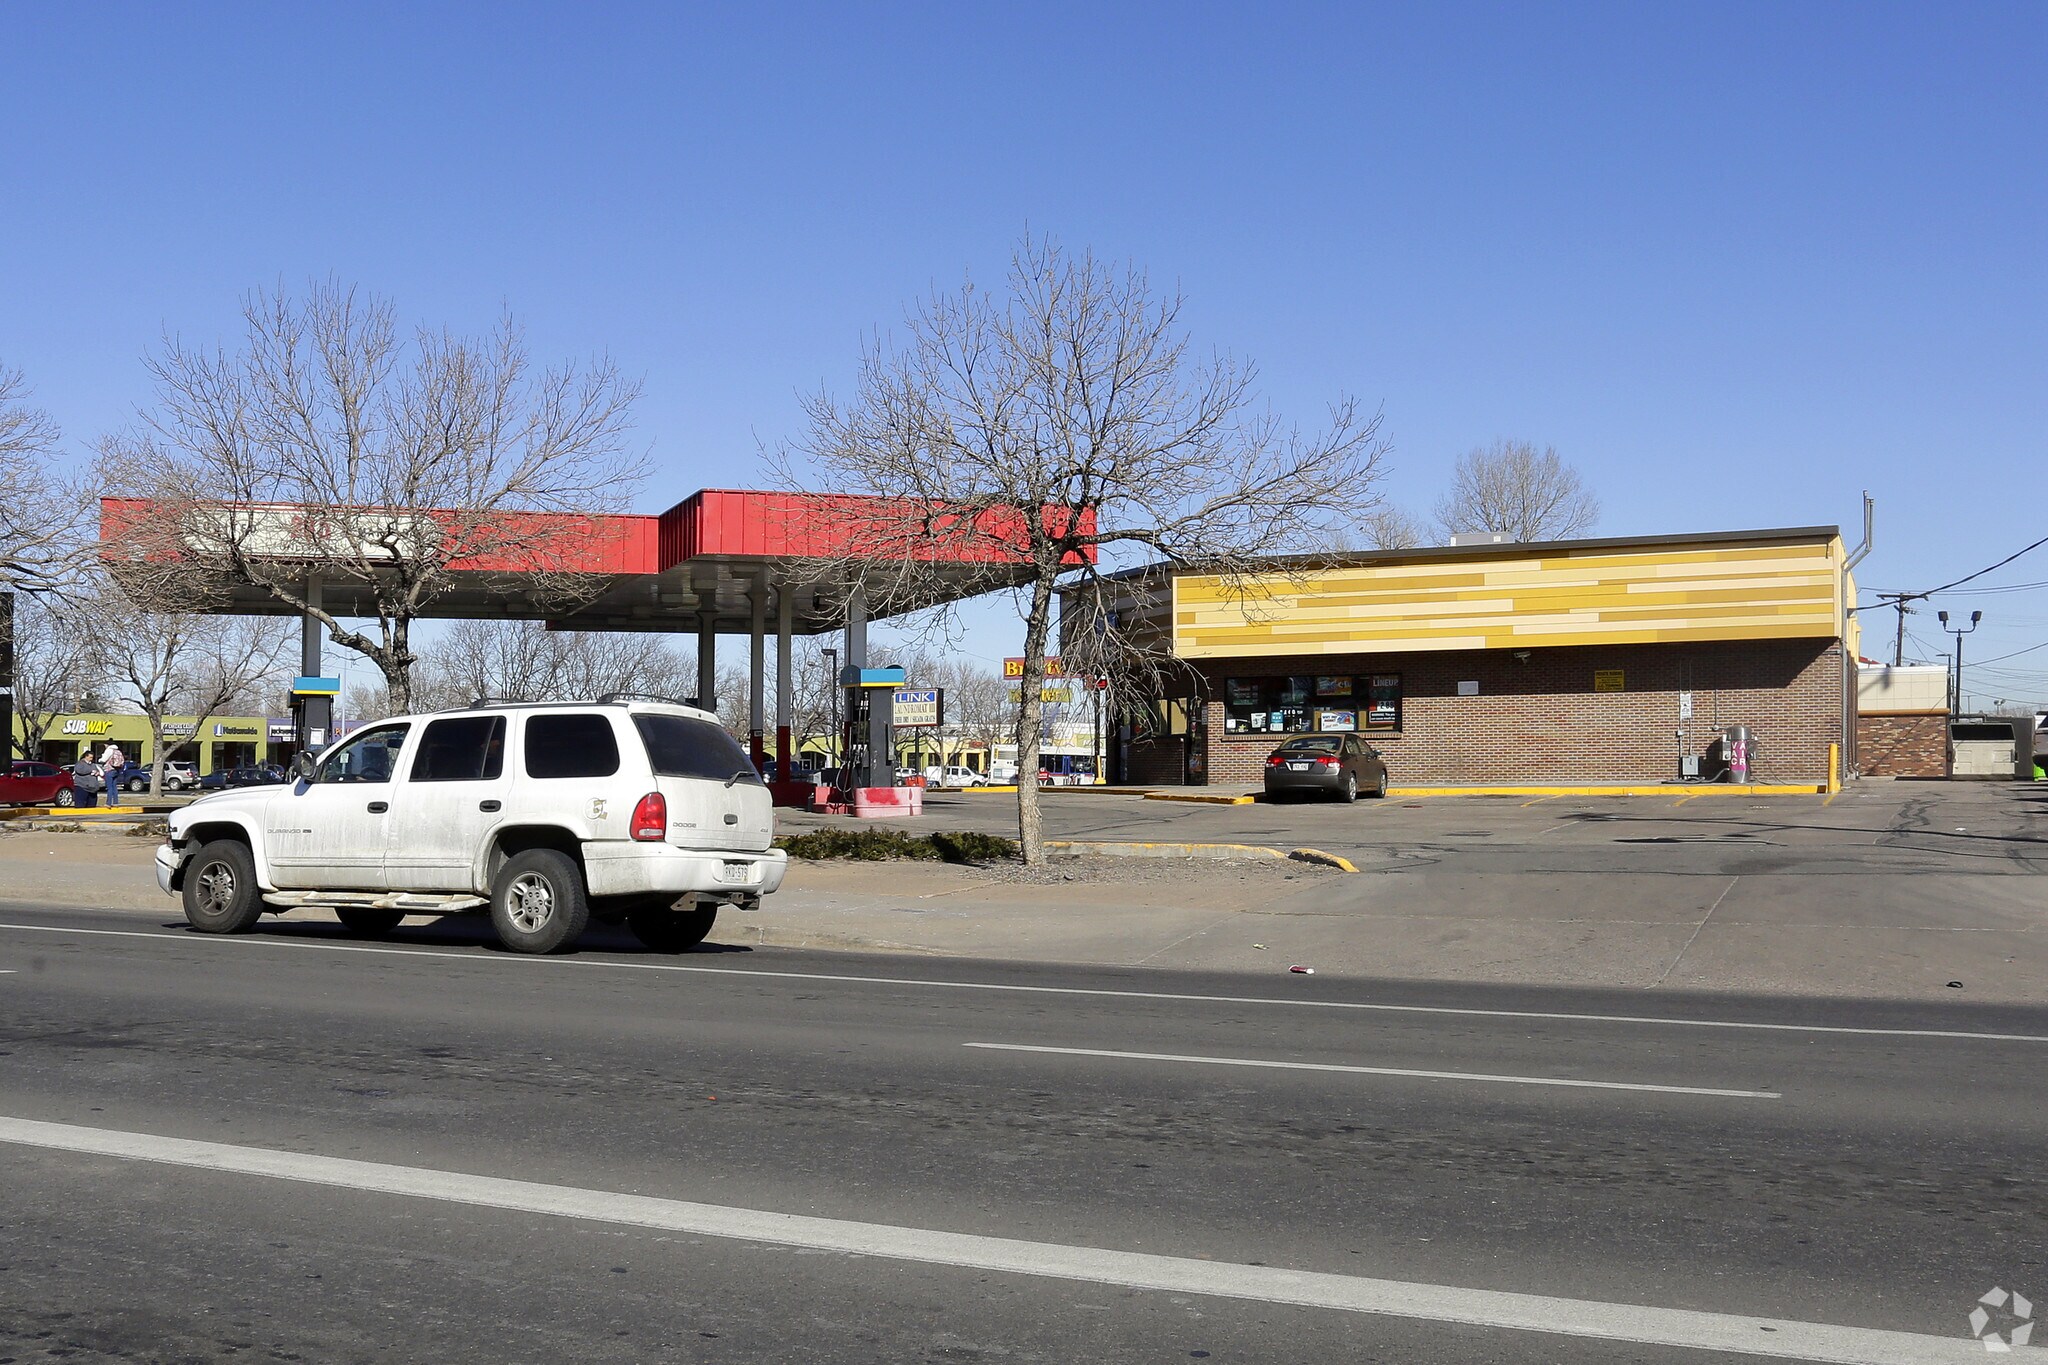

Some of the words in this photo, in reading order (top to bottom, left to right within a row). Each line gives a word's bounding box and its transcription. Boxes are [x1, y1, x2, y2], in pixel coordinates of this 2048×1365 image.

[899, 693, 931, 702] LINK
[895, 704, 927, 714] LAUNDROMAT
[63, 720, 112, 734] SUBWAY
[223, 726, 257, 735] Nationwide
